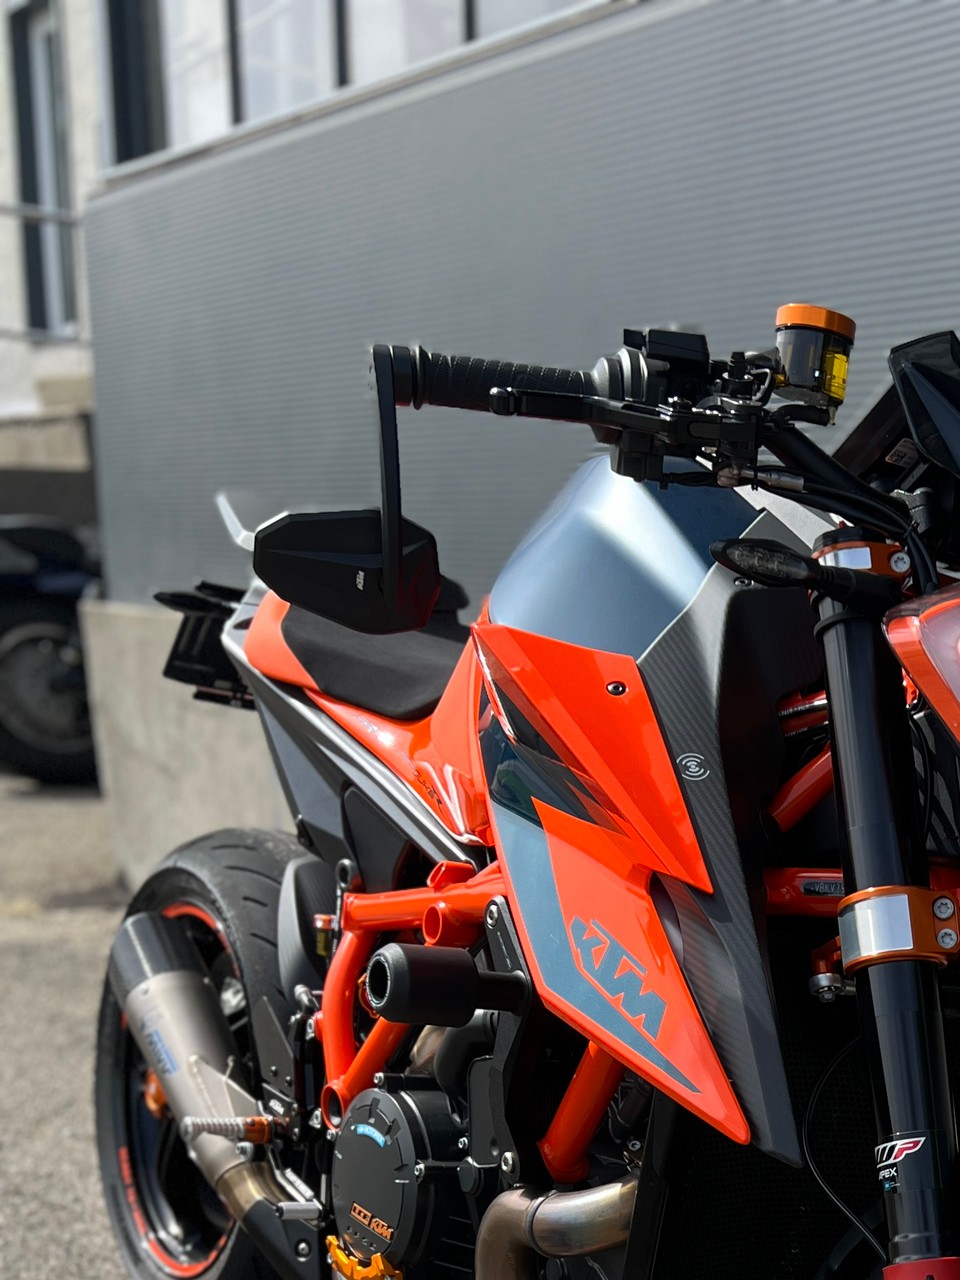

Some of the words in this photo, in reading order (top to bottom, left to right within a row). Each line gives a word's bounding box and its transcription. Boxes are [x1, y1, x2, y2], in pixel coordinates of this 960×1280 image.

[570, 915, 667, 1040] KTM
[874, 1136, 927, 1168] WP
[371, 1217, 394, 1241] KTM
